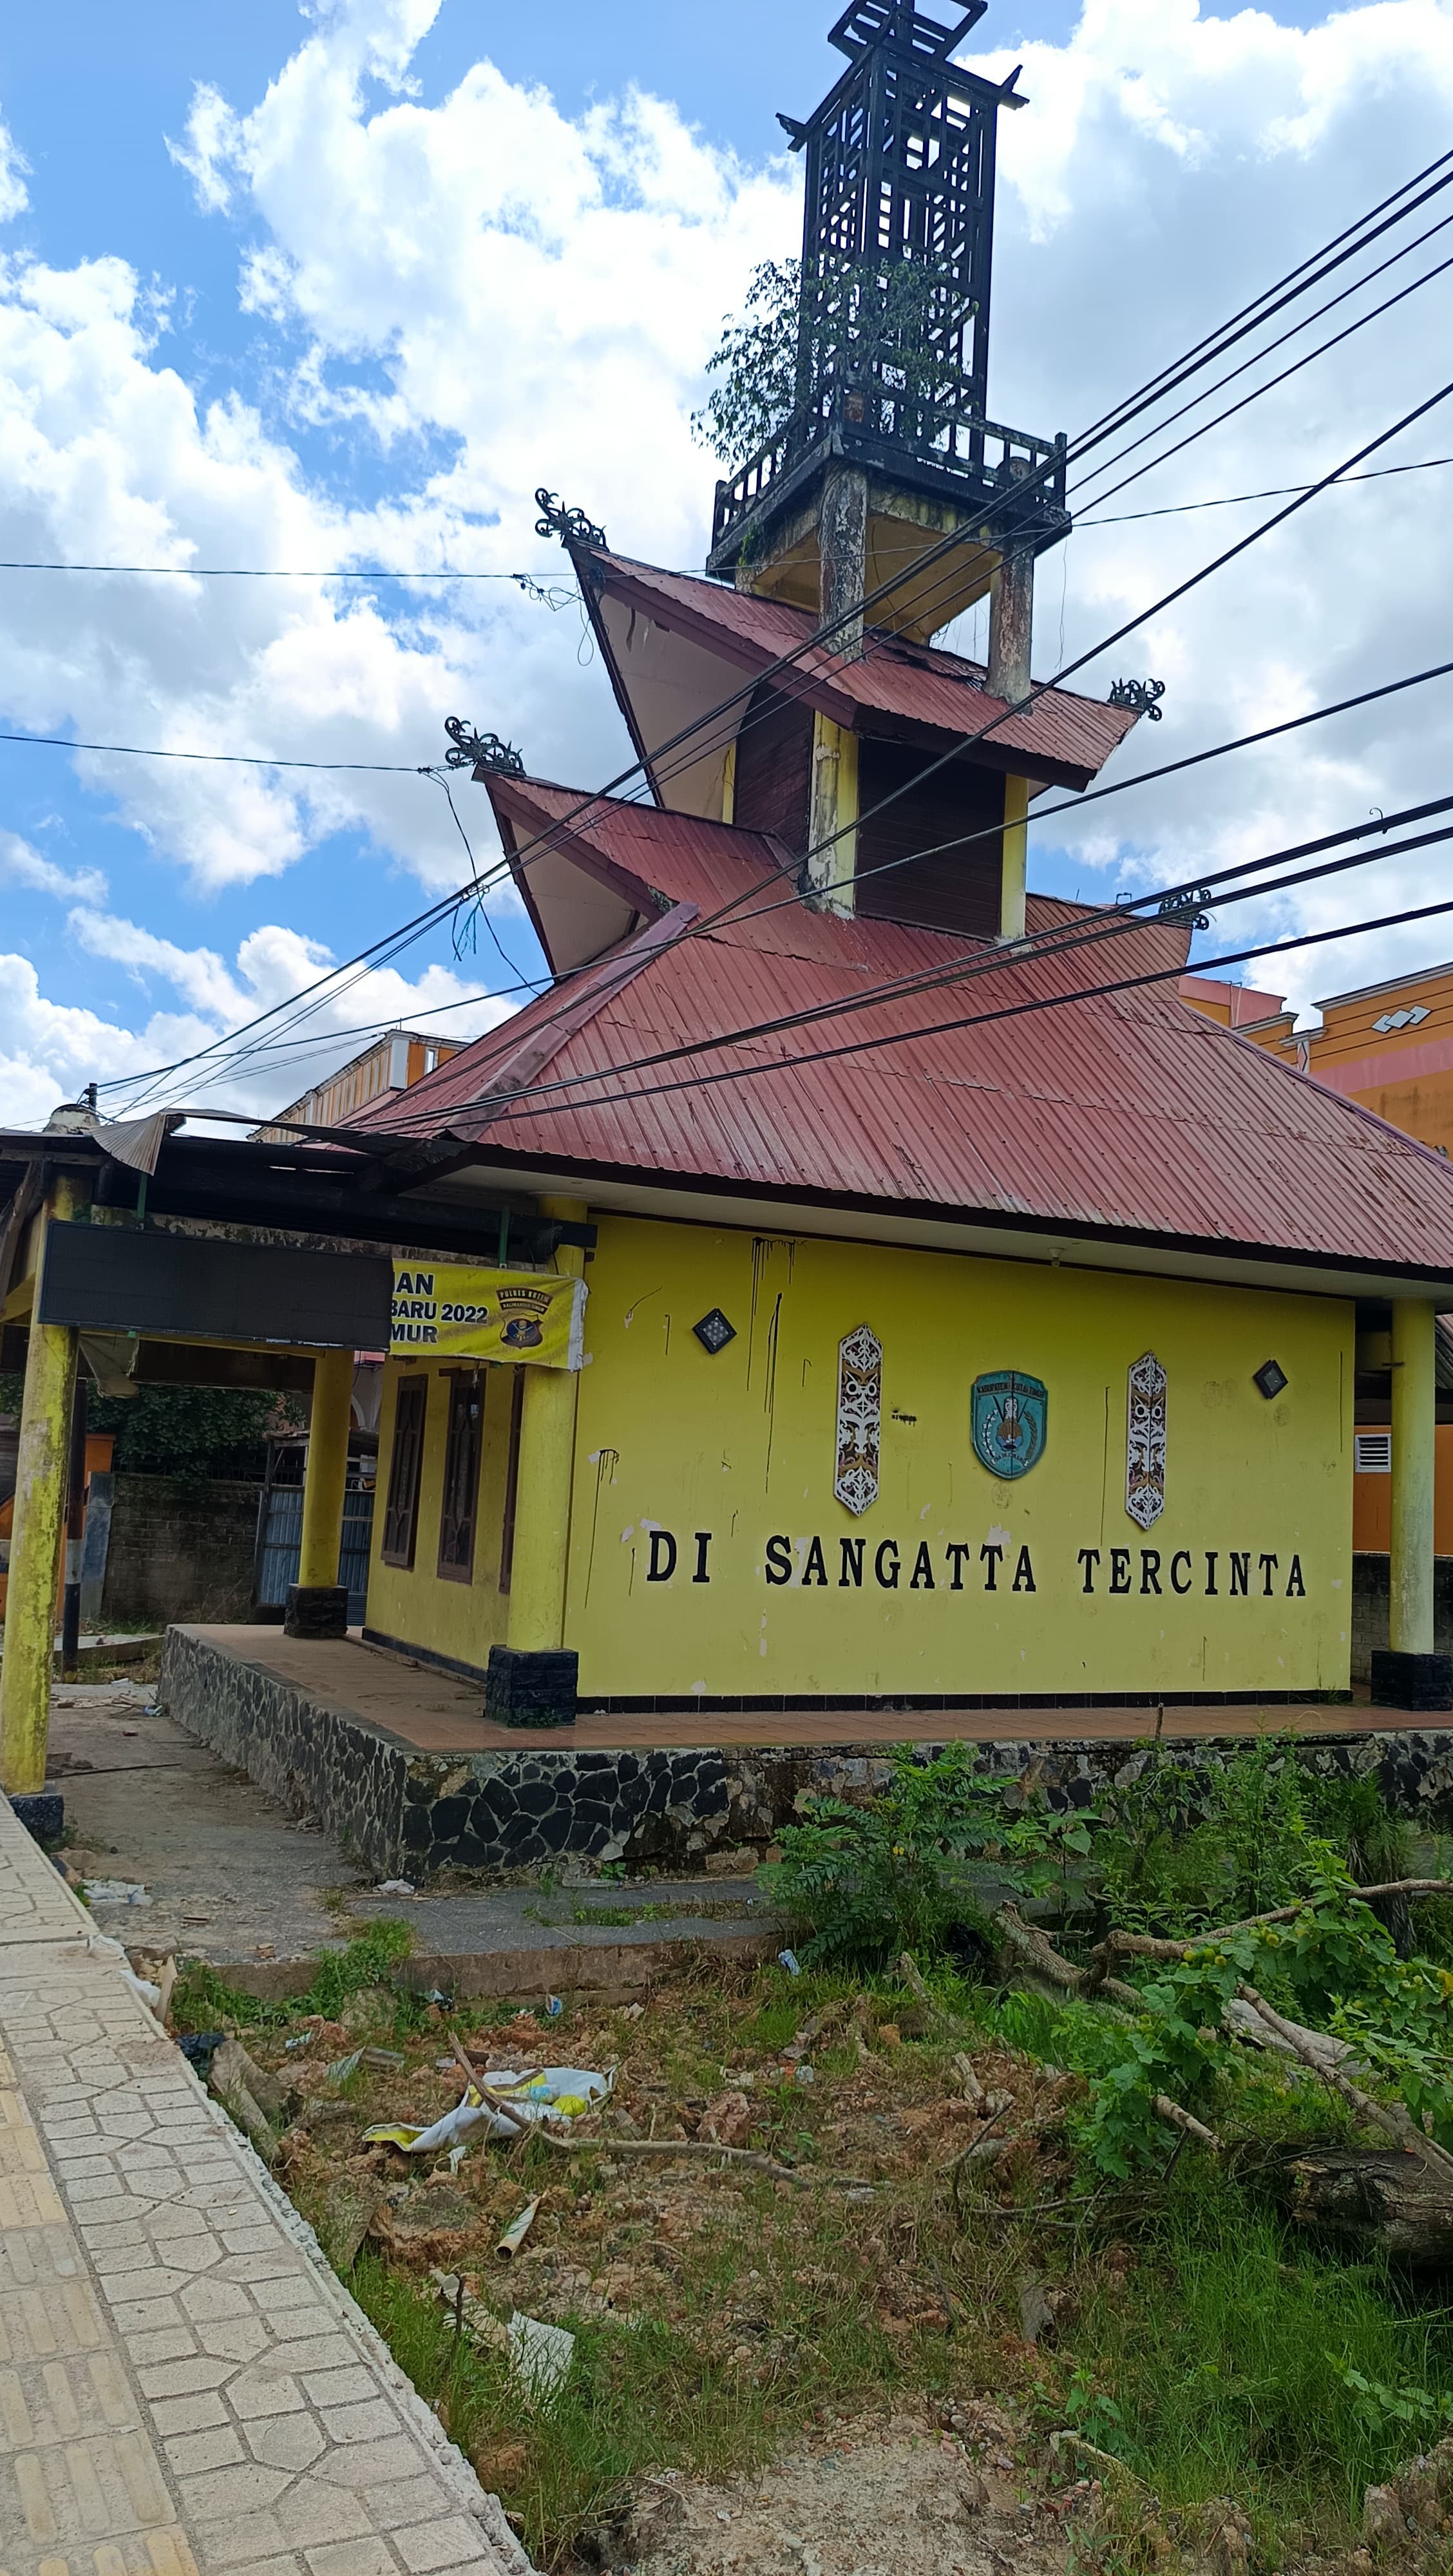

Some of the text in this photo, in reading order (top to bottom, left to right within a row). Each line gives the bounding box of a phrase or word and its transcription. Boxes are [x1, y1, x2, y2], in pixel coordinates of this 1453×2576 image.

[394, 1272, 434, 1295] AN
[392, 1299, 488, 1324] BARU 2022
[647, 1531, 1306, 1596] DI SANGATTA TERCINTA
